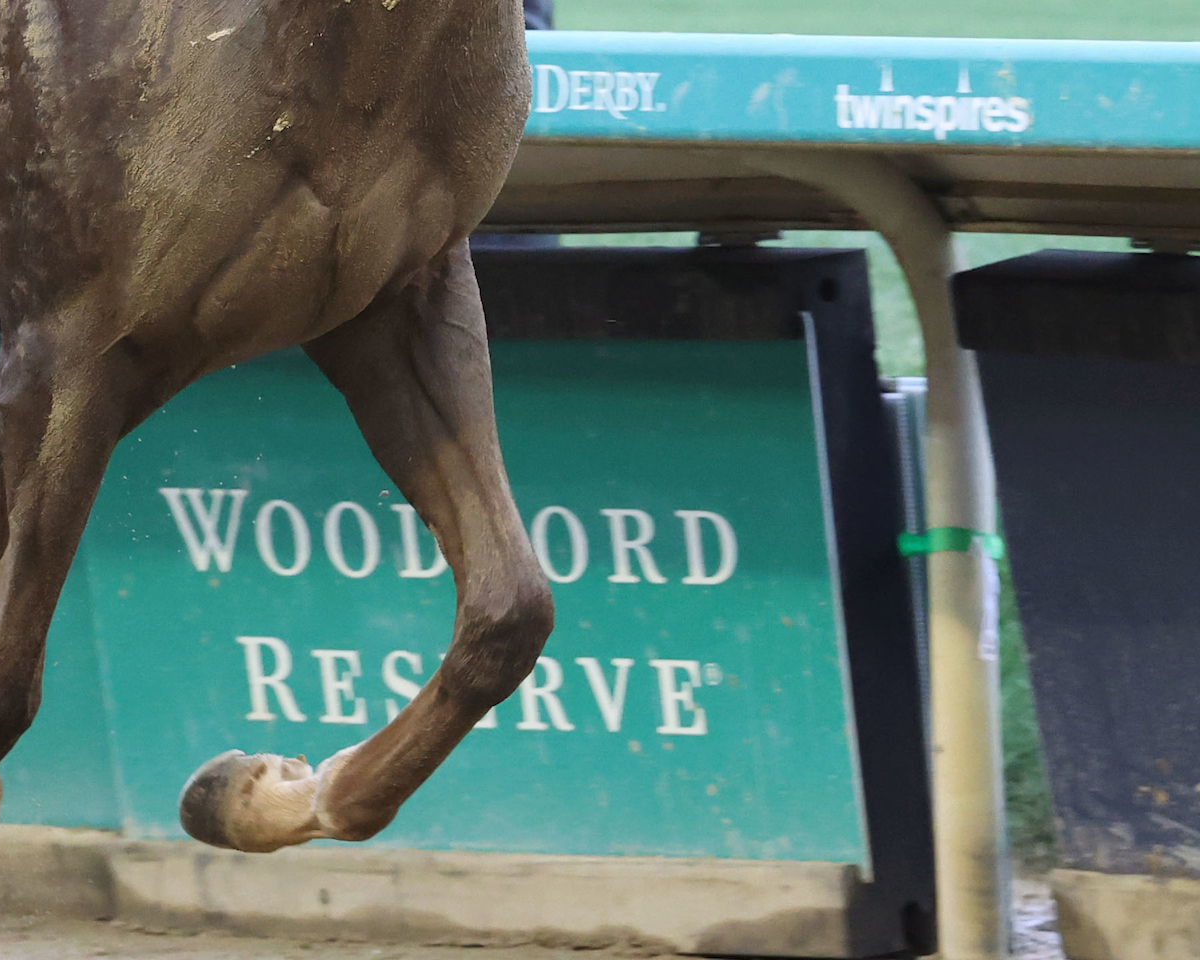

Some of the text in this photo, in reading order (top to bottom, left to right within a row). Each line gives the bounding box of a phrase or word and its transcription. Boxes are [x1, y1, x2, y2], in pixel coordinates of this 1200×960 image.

[834, 82, 1032, 140] twinspires
[158, 486, 739, 586] WOODORD
[235, 635, 708, 735] RESRVE
